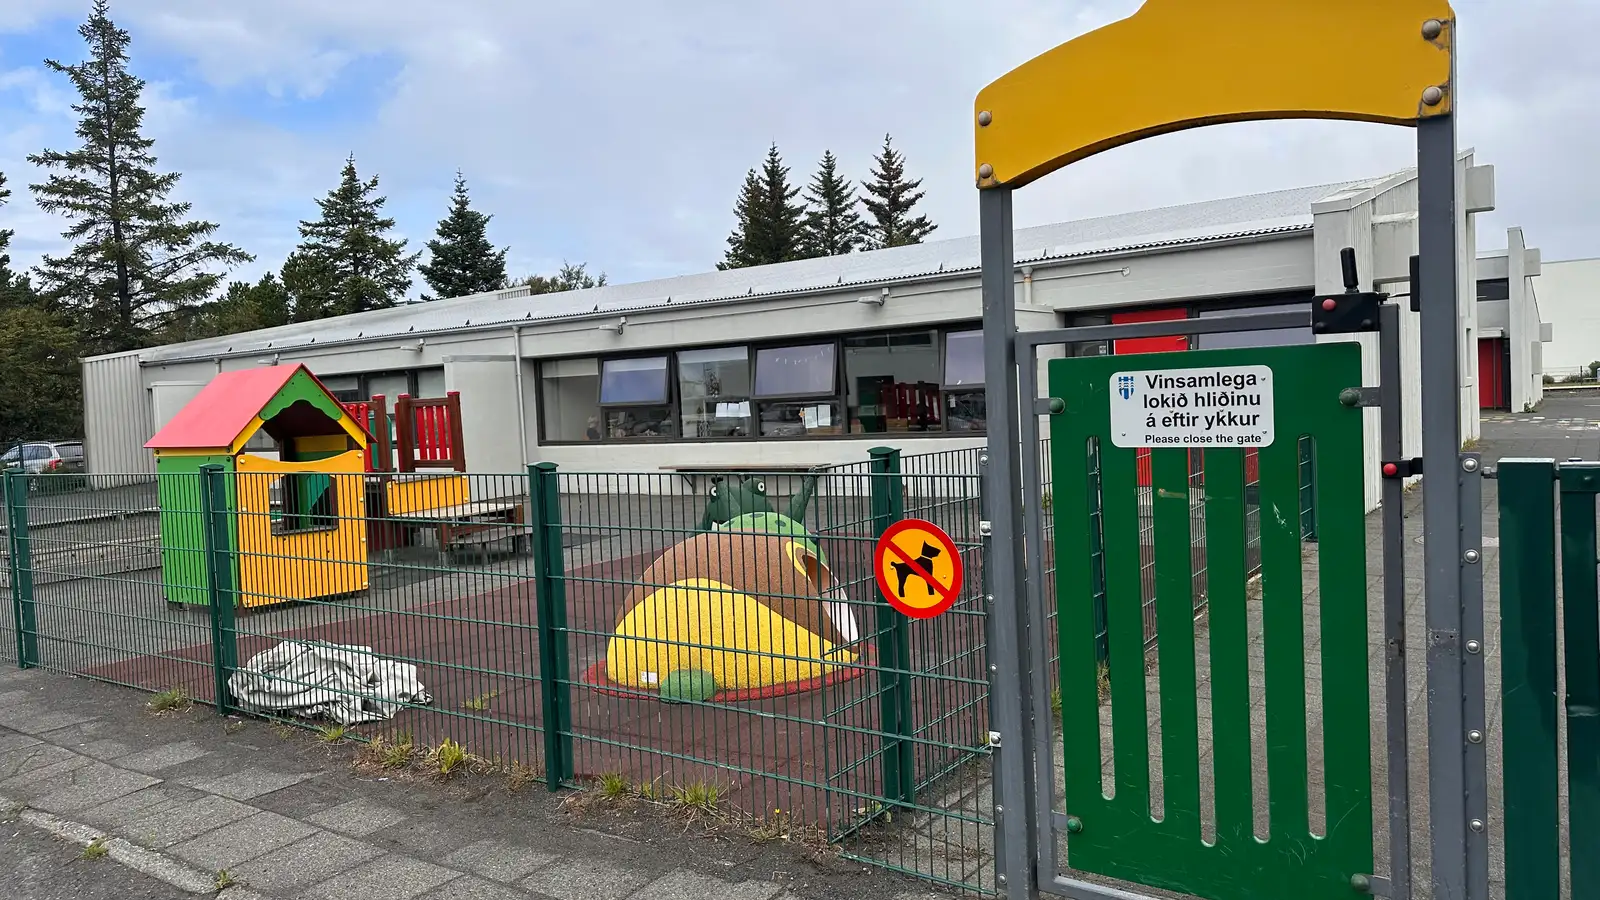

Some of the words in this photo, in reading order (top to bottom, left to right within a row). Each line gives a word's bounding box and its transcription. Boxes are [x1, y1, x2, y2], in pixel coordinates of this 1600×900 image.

[1145, 371, 1257, 390] Vinsamlega
[1143, 393, 1188, 409] lokið
[1194, 391, 1261, 407] hliðinu
[1146, 412, 1156, 428] á
[1161, 412, 1199, 427] eftir
[1204, 410, 1260, 430] ykkur
[1145, 434, 1180, 444] Please
[1183, 434, 1213, 443] close
[1216, 433, 1234, 443] the
[1236, 434, 1262, 445] gate
